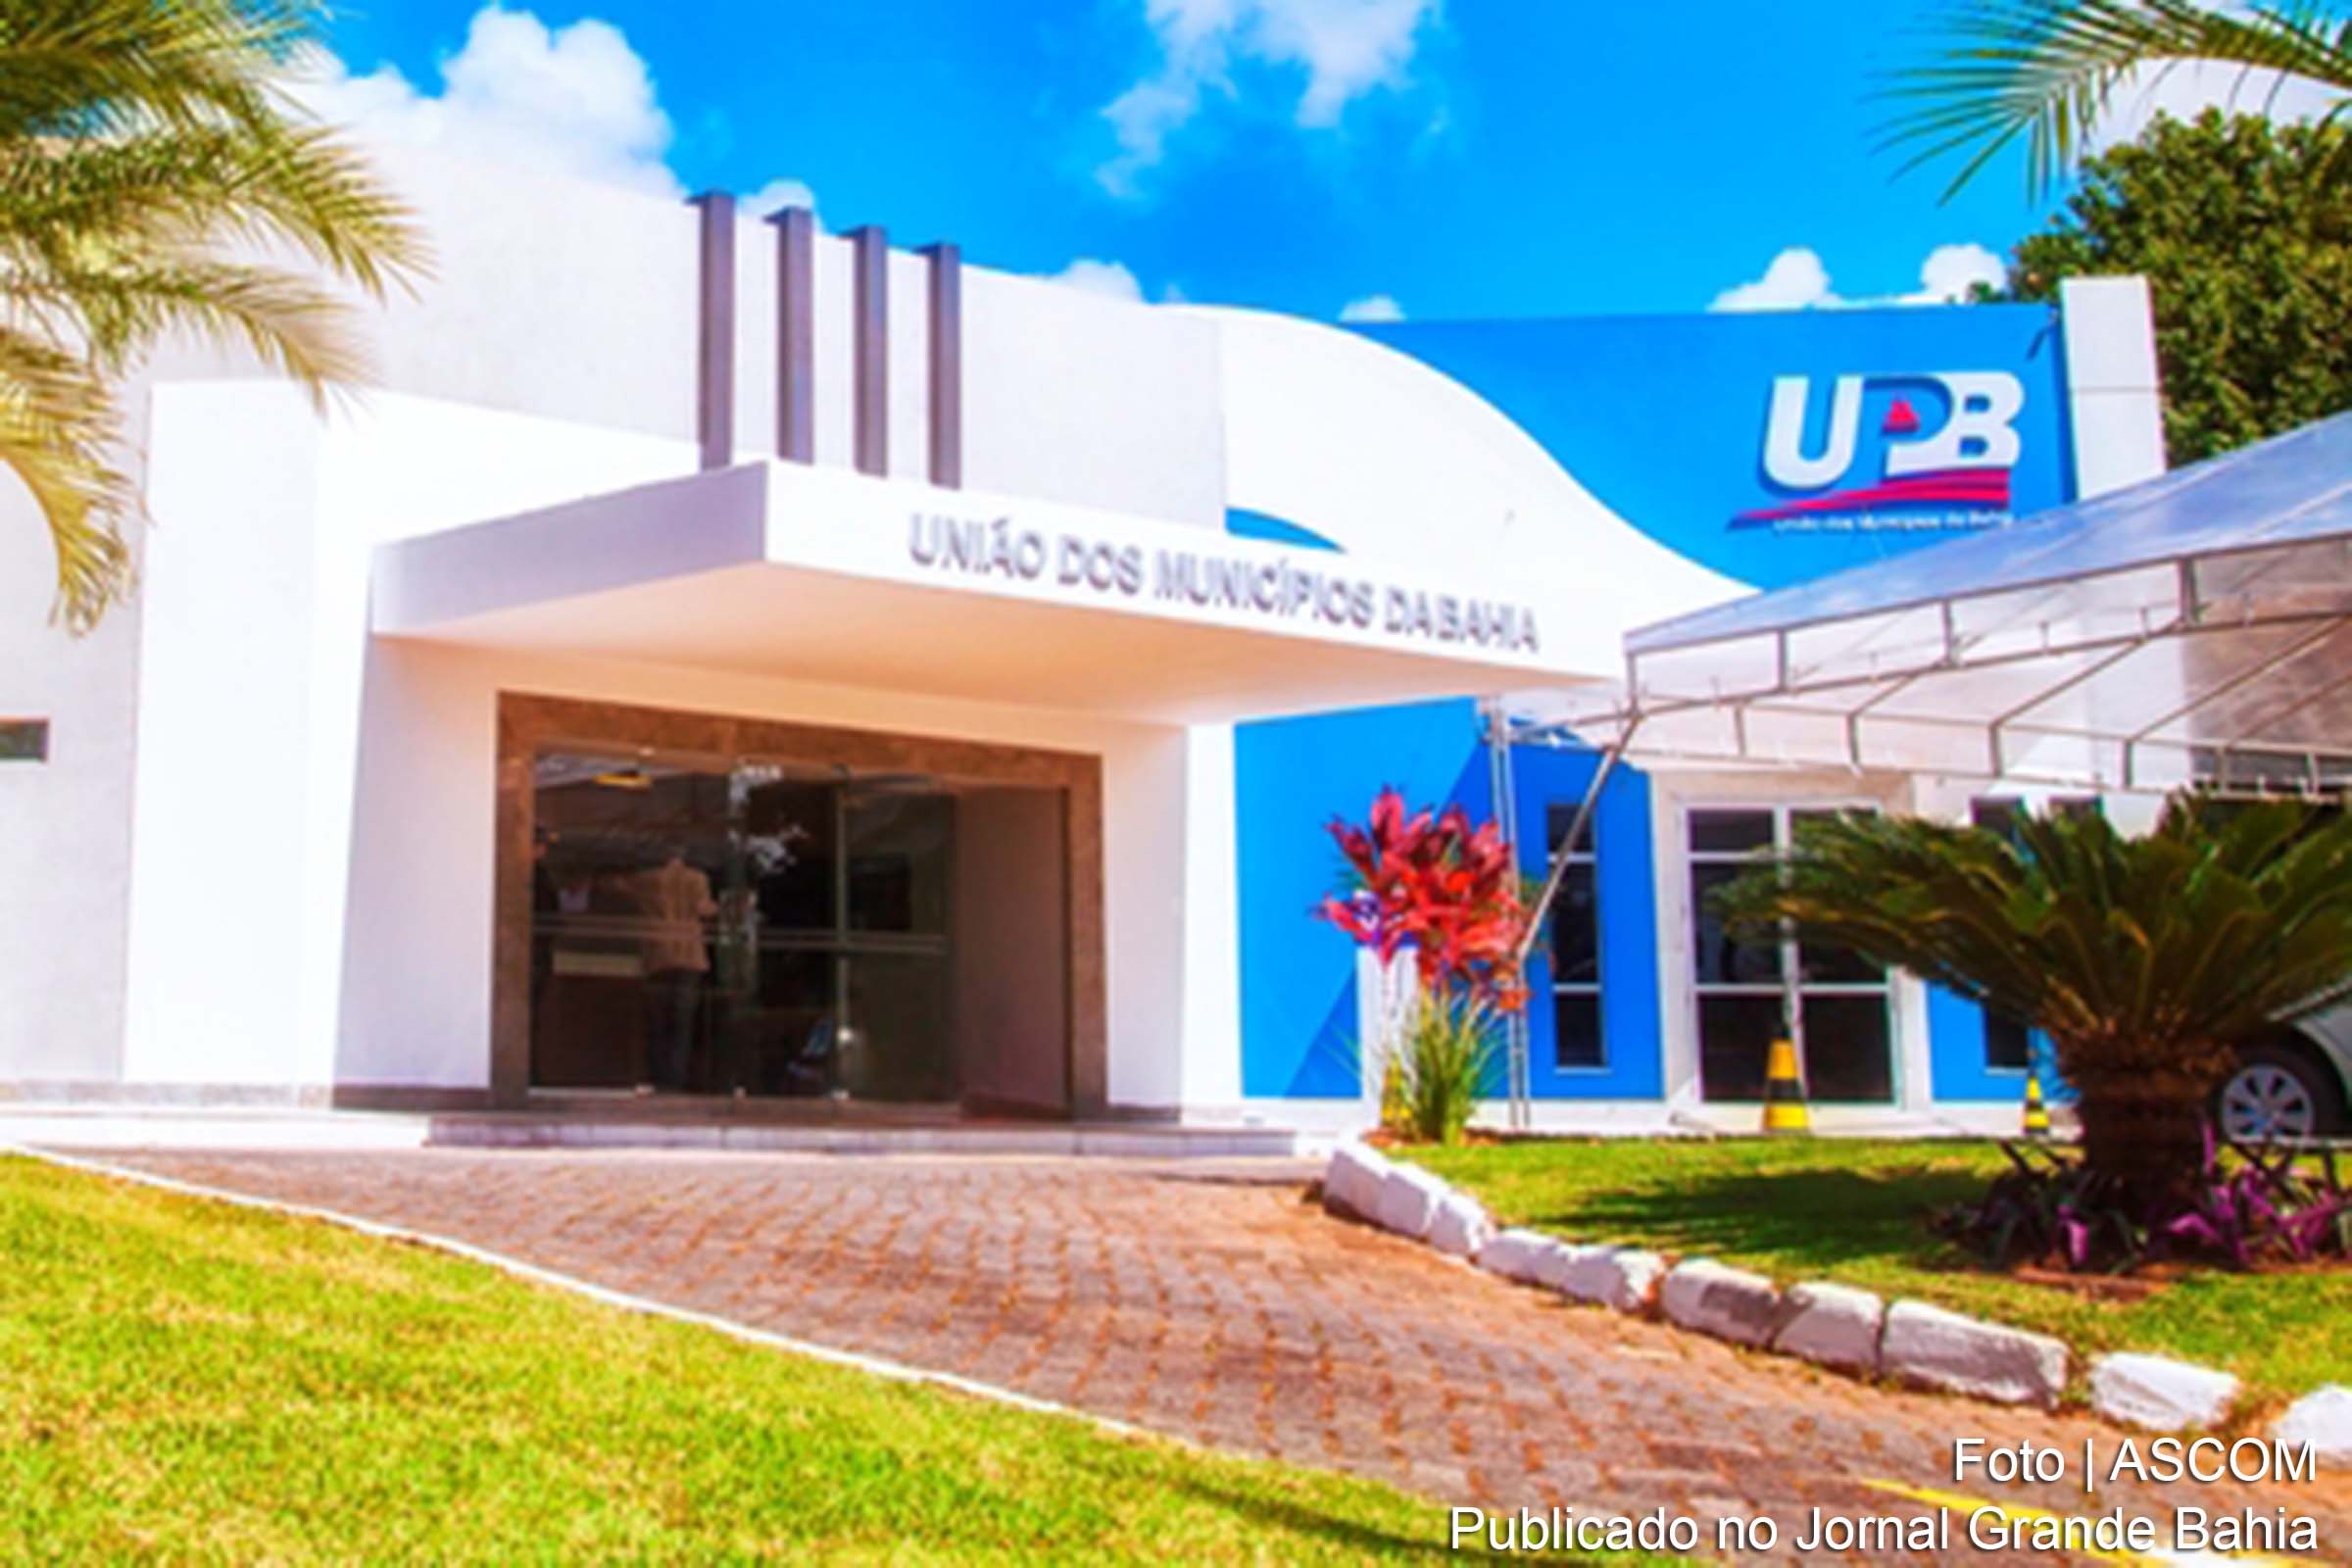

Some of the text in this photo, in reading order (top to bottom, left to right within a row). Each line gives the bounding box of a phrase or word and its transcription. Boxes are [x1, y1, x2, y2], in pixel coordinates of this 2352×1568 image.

[1761, 370, 2026, 490] UPB
[908, 512, 1047, 581] UNIÃO
[1056, 534, 1144, 596] DOS
[1152, 548, 1375, 629] MUNICÍPIOS
